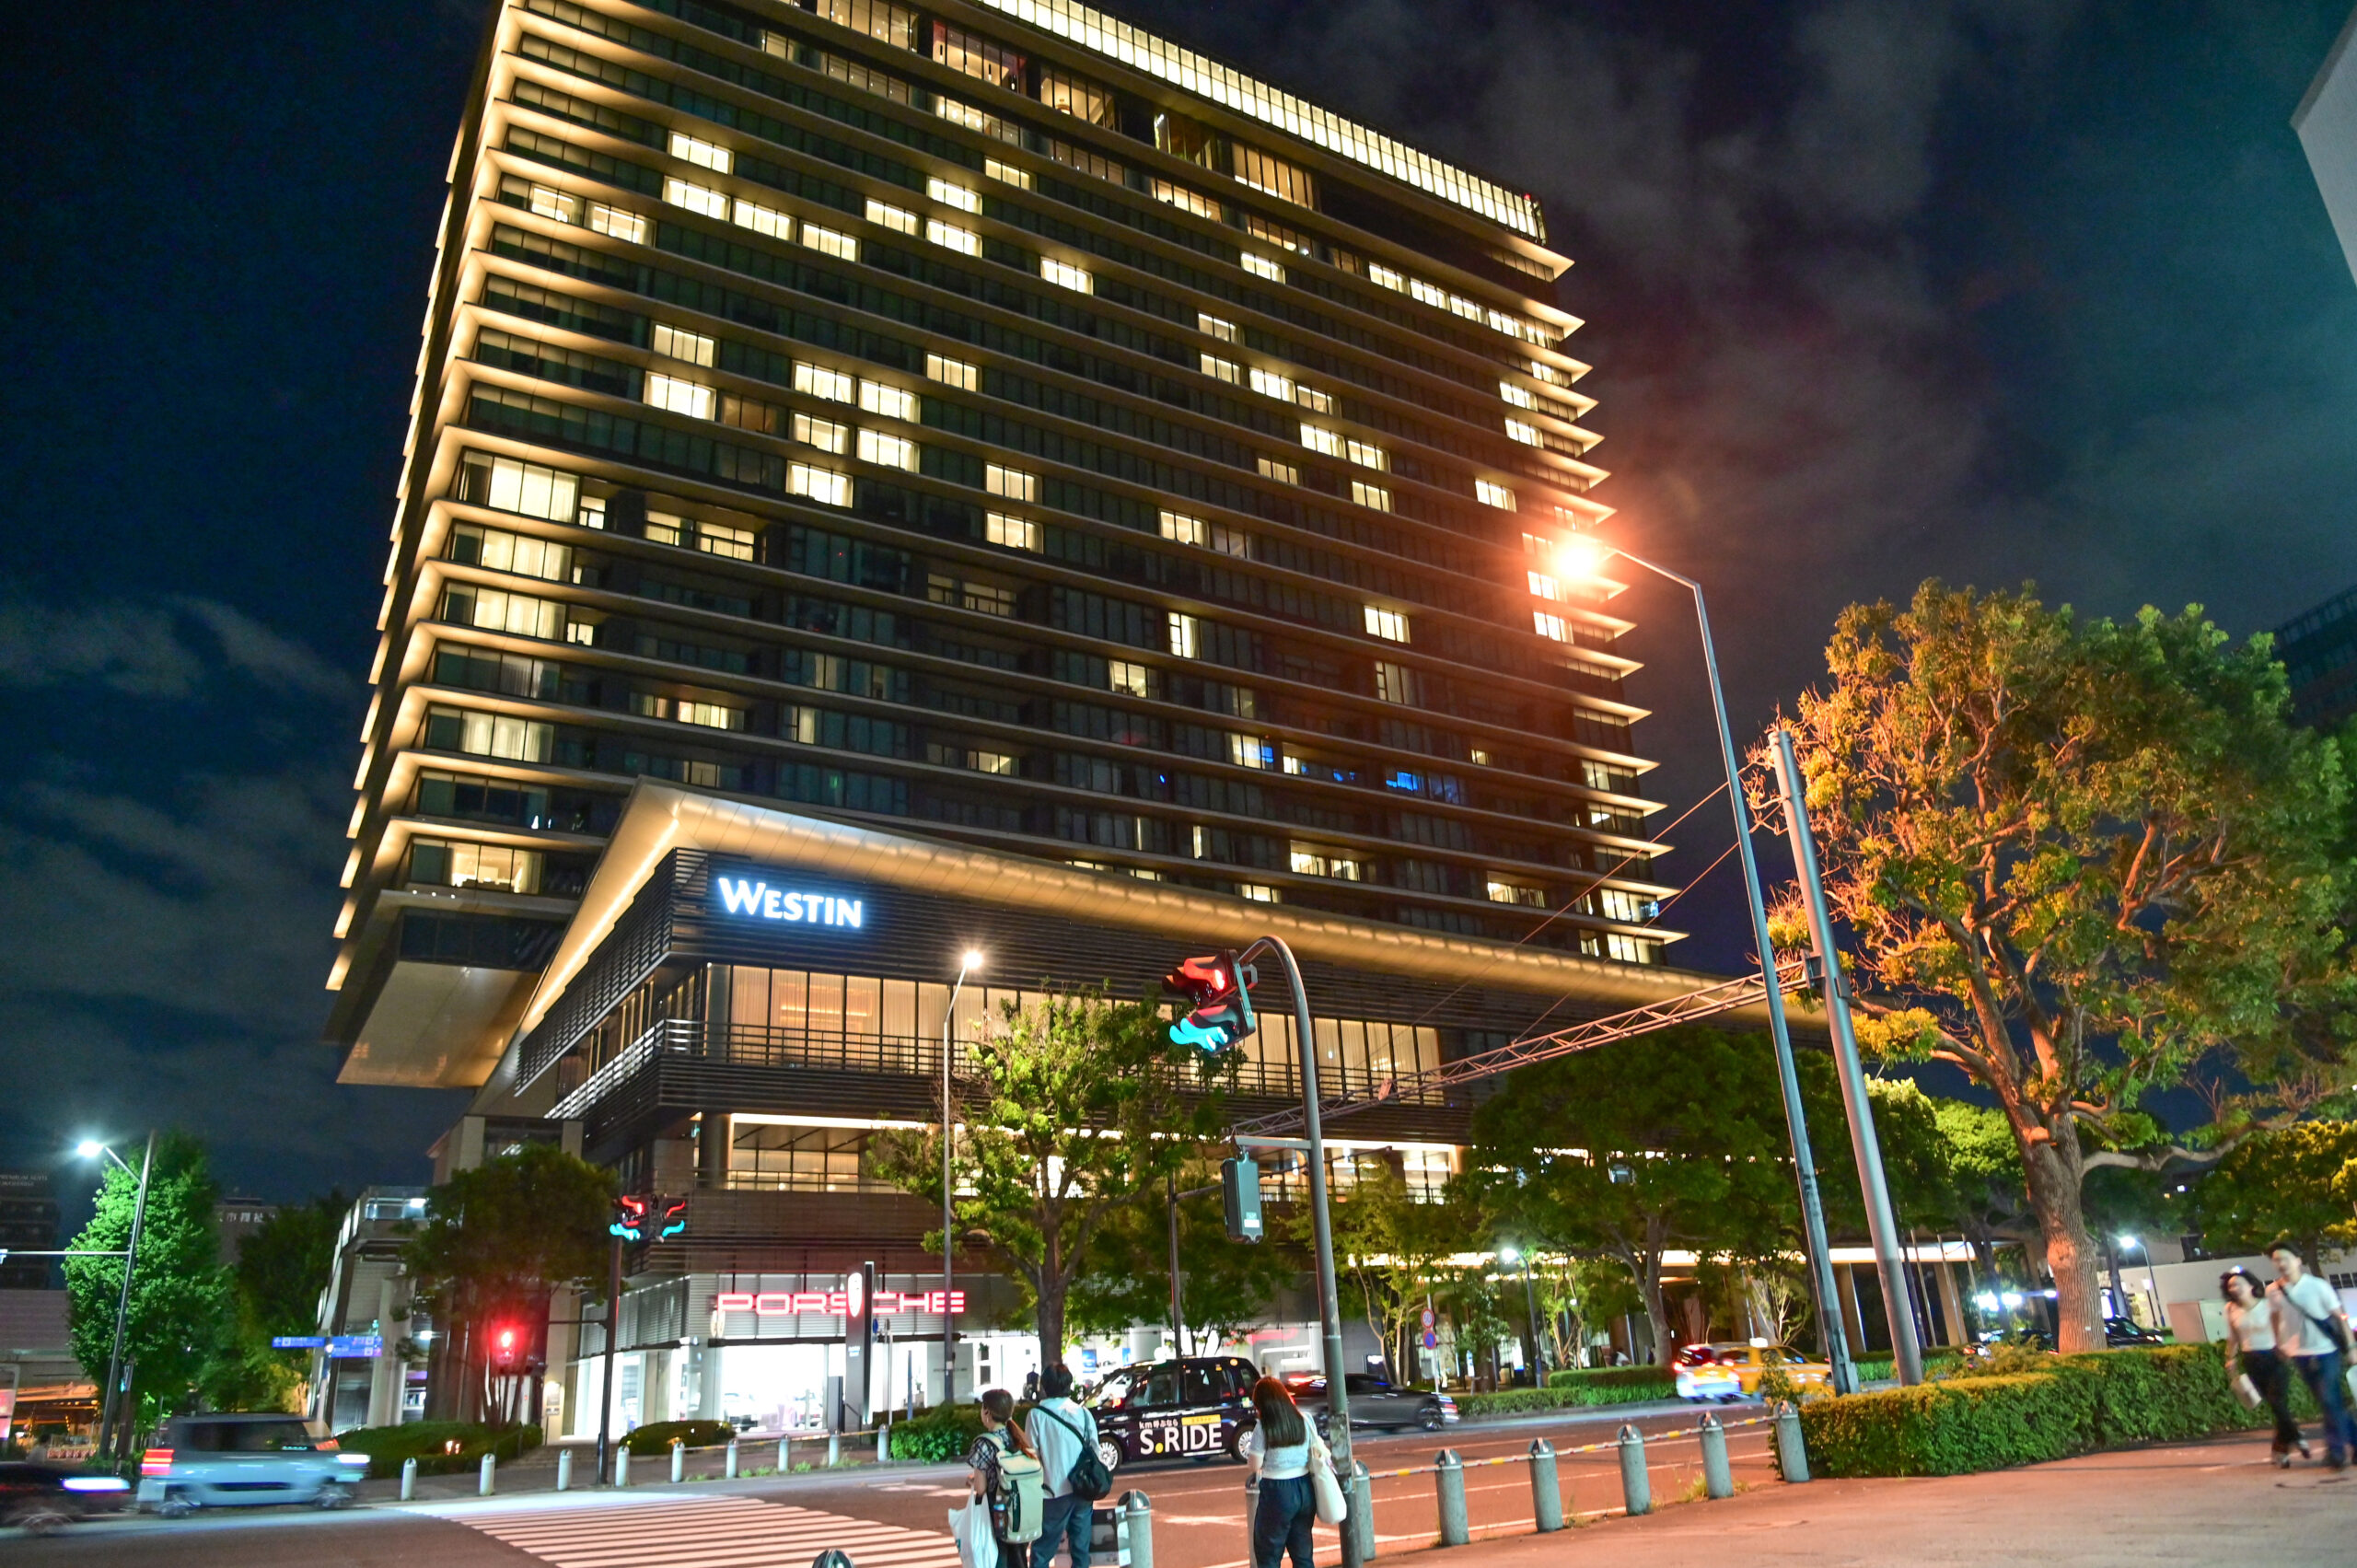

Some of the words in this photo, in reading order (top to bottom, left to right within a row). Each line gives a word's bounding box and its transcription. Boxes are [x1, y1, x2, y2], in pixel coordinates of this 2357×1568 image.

[718, 877, 862, 927] WESTIN
[717, 1291, 965, 1316] PORSCHE
[1139, 1423, 1223, 1456] S.RIDE
